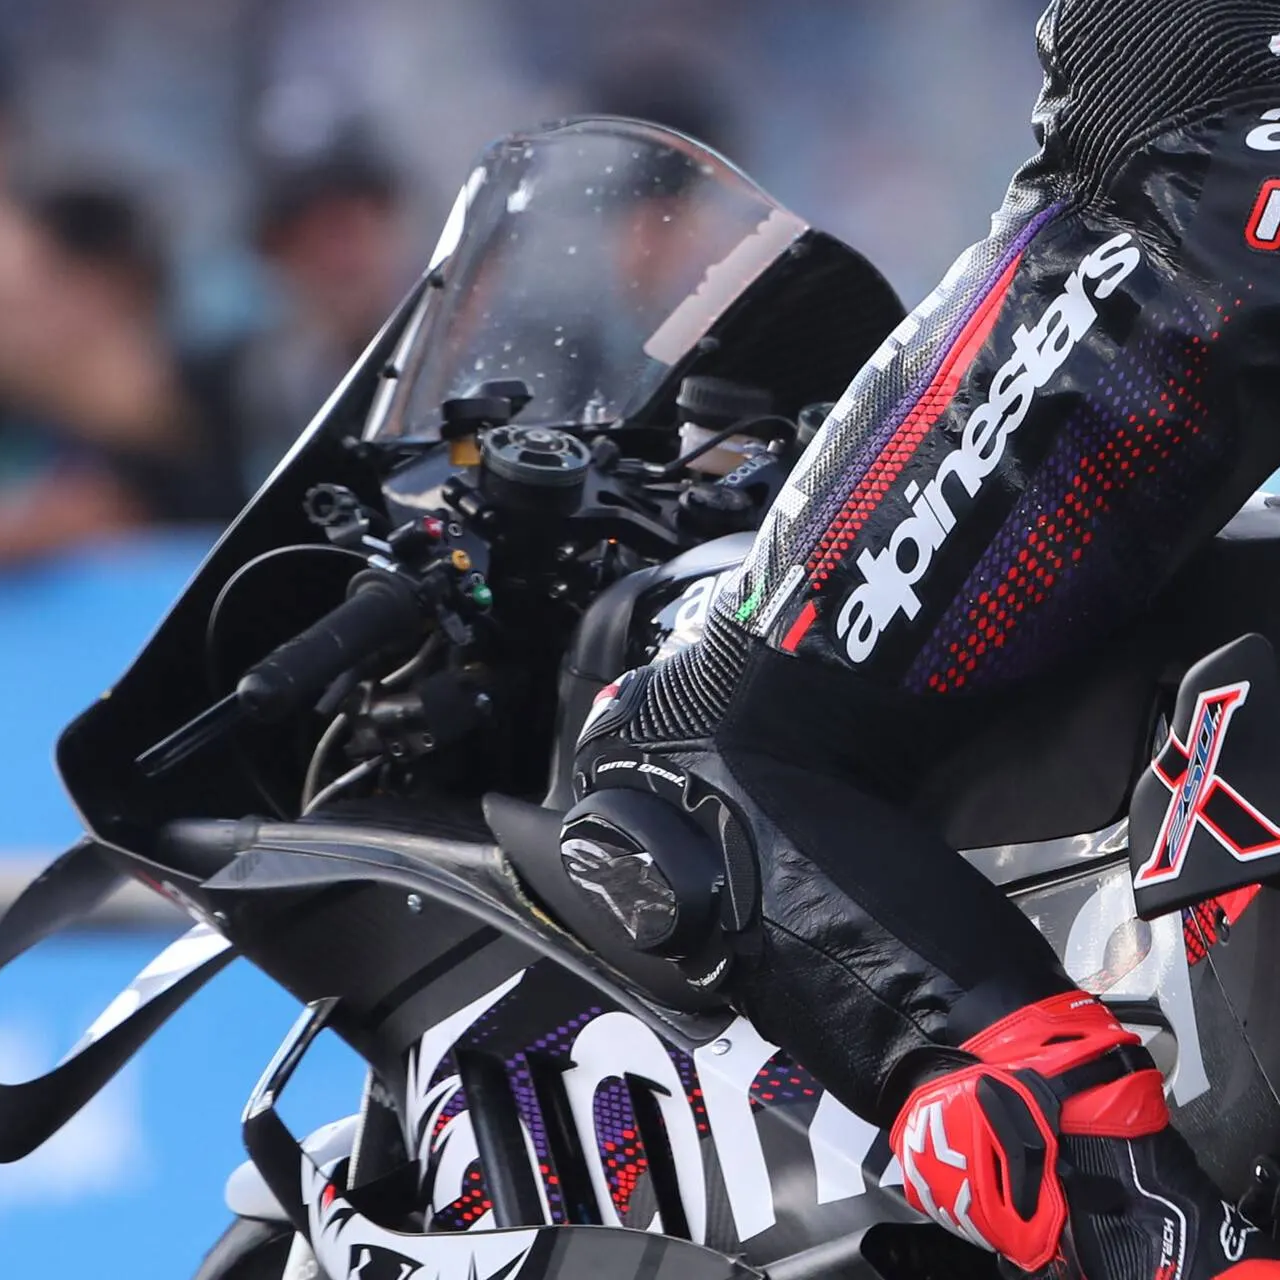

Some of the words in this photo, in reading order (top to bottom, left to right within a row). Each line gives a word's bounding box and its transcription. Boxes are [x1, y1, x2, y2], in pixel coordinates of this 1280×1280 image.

[836, 232, 1141, 665] alpinestars
[597, 760, 637, 773] one
[637, 763, 686, 788] goal.
